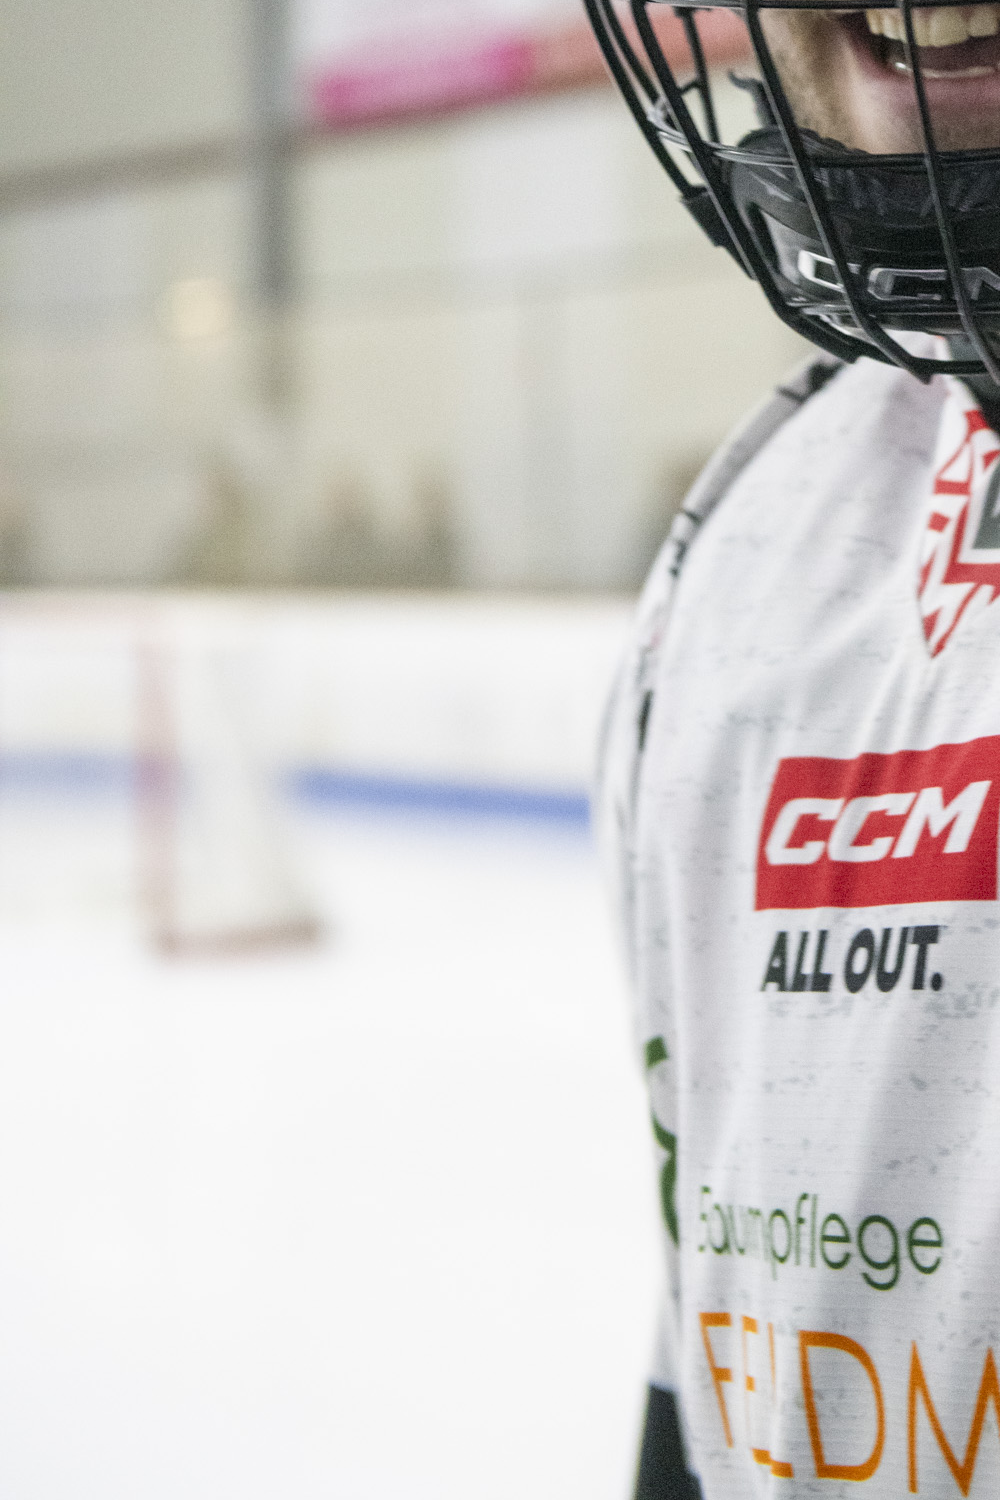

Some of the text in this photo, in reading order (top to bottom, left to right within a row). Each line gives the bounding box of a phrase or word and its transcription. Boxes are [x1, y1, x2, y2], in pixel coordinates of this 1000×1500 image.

[764, 779, 992, 865] CCM
[760, 924, 945, 994] ALL OUT.
